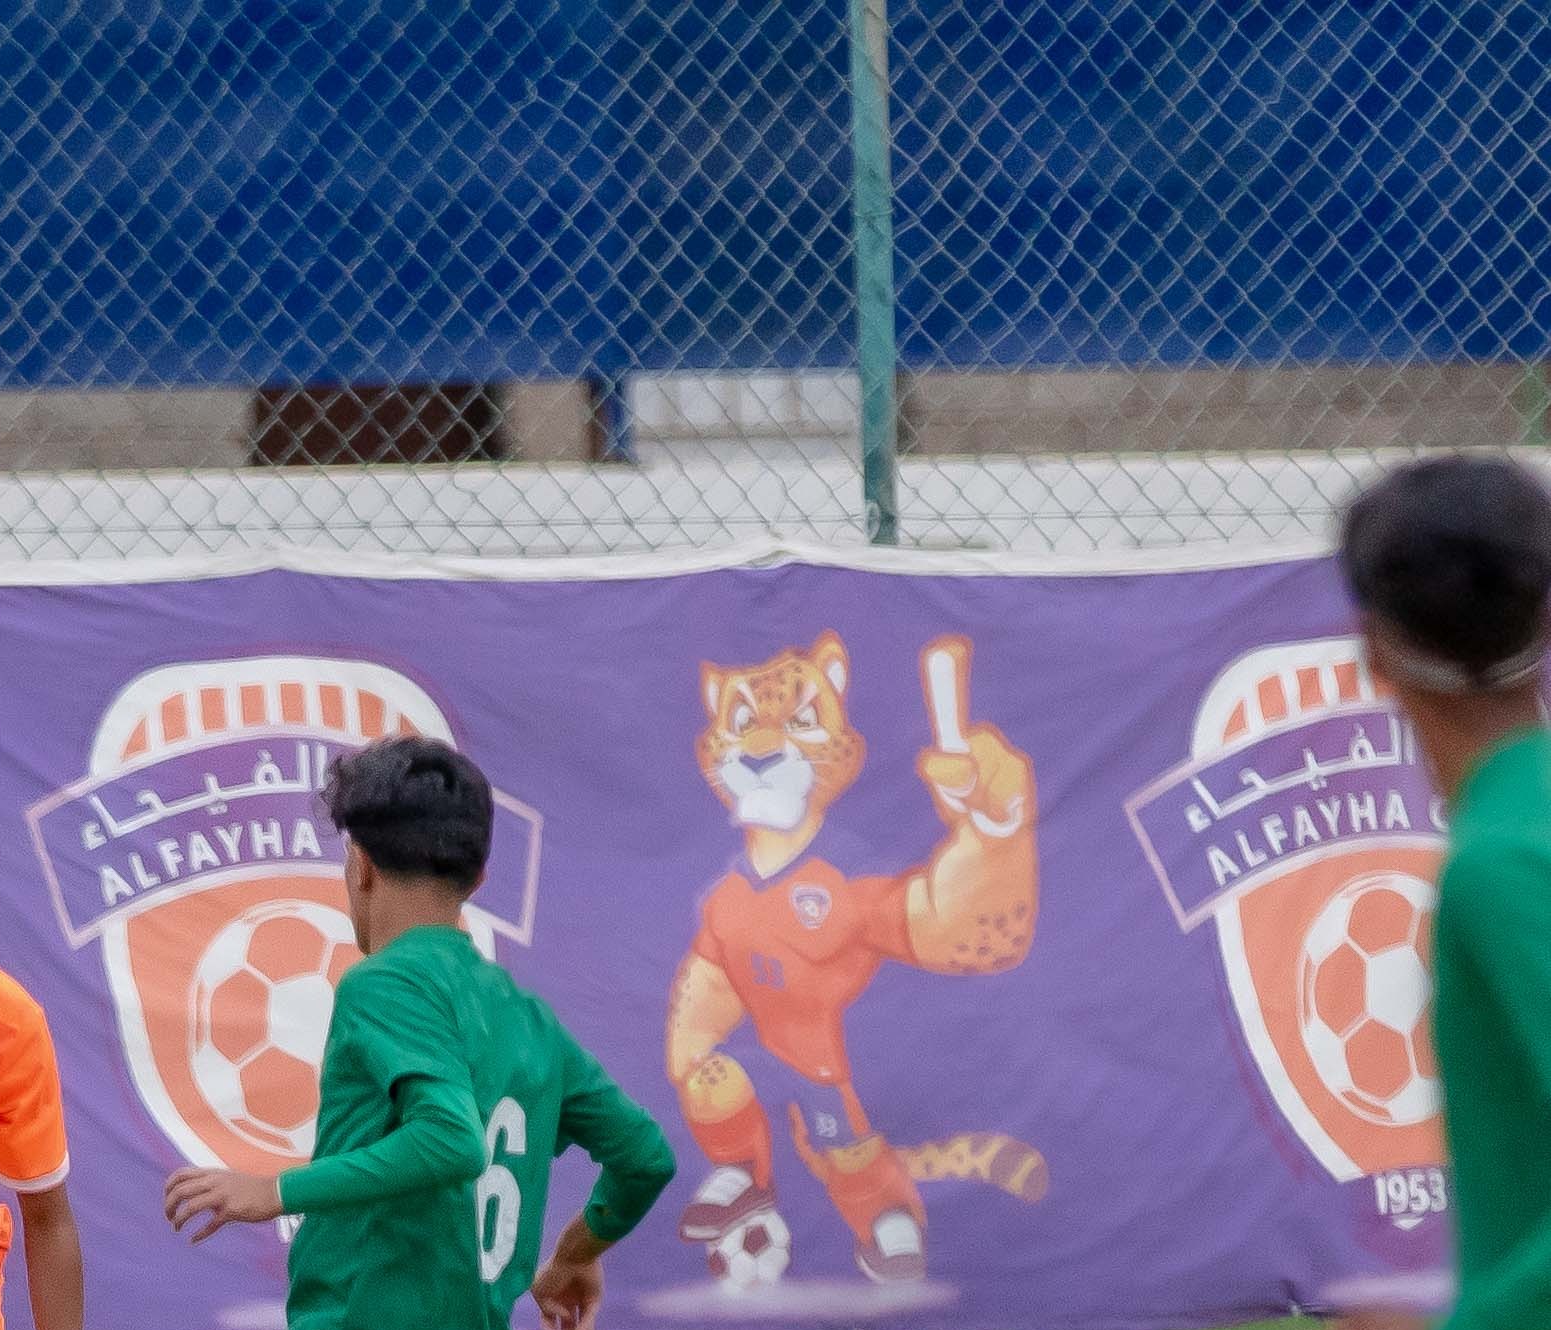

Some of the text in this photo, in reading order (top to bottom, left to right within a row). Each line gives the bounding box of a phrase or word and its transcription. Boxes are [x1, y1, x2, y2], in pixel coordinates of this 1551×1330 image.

[82, 743, 328, 850] الفيحاء
[1206, 790, 1411, 886] ALFAYHA
[100, 819, 323, 905] ALFAYHA
[475, 1096, 527, 1283] 6
[1374, 1168, 1448, 1215] 1953
